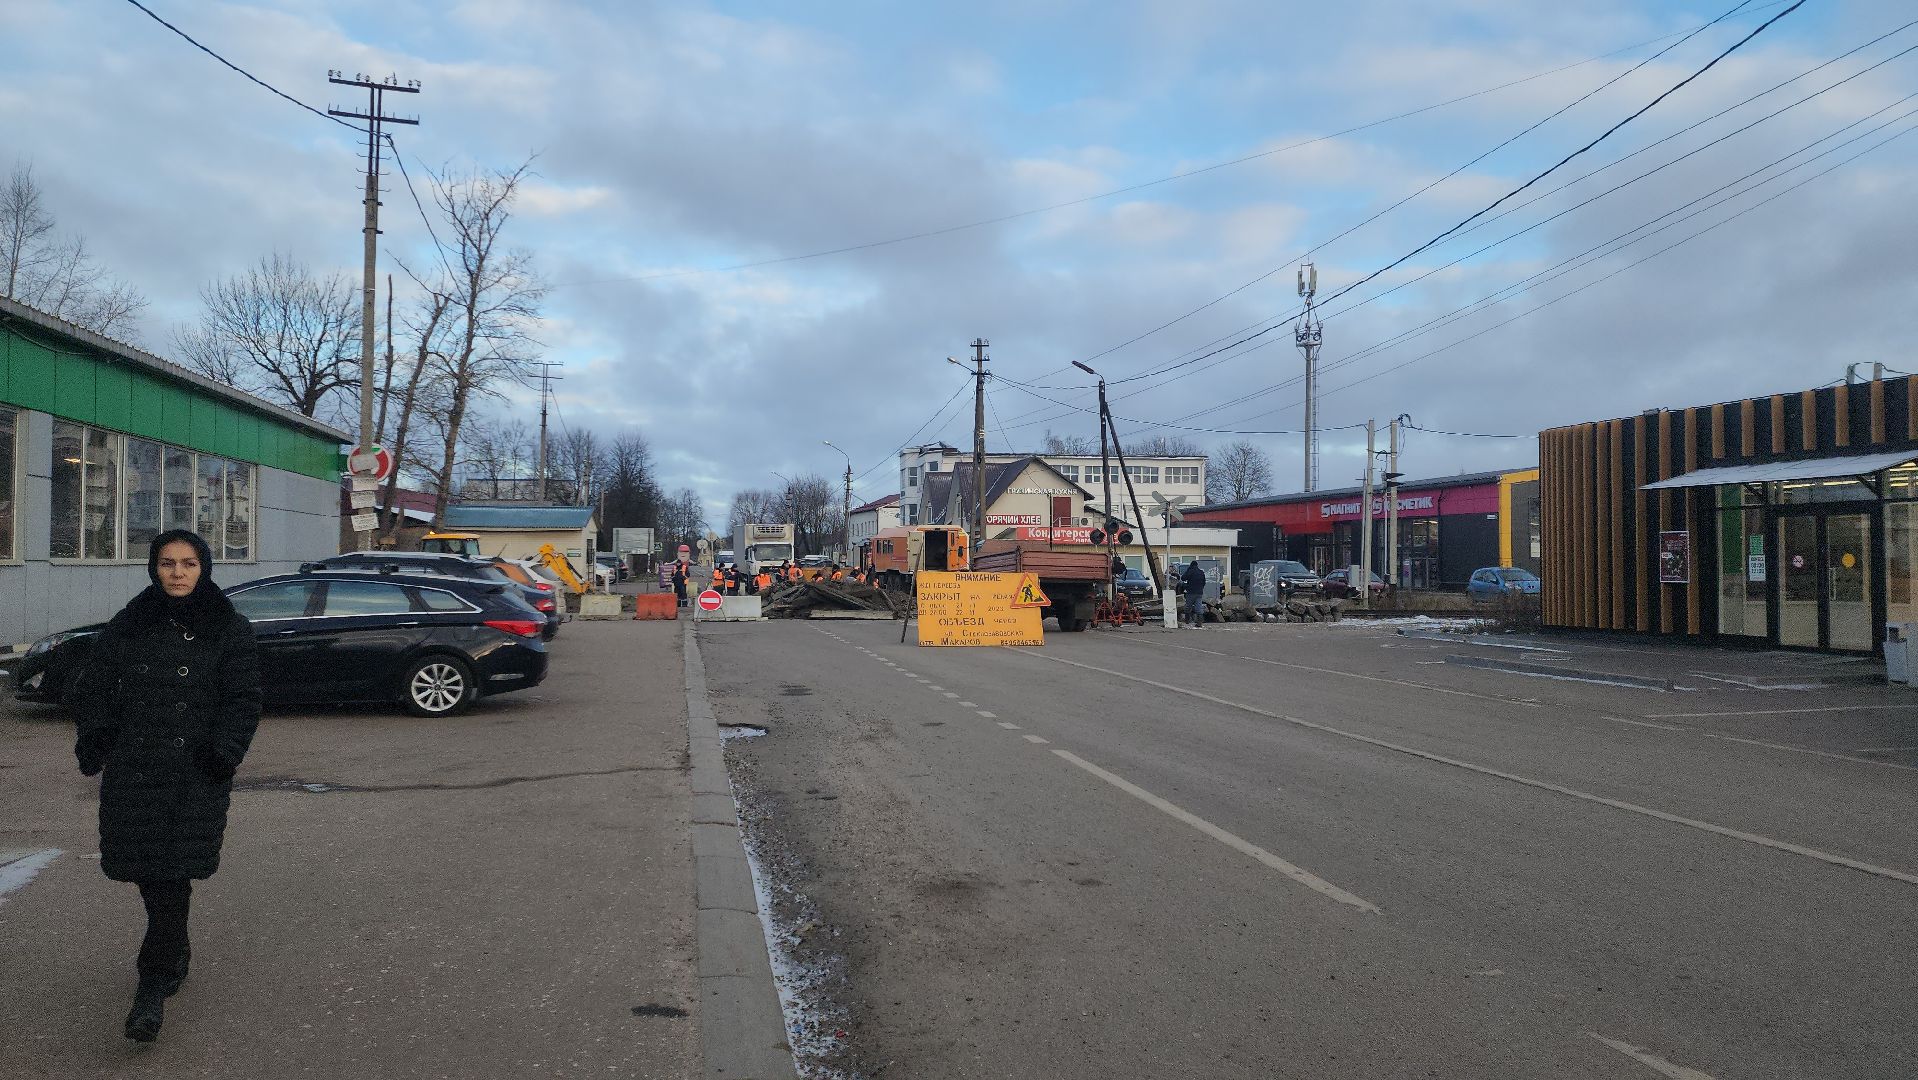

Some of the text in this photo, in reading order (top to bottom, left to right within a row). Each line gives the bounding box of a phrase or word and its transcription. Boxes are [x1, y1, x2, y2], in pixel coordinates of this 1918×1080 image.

[1330, 502, 1361, 515] МАГНИТ
[1021, 515, 1041, 525] ХЛЕБ
[955, 573, 1002, 582] ВНИМАНИЕ
[920, 592, 961, 601] ЗАКРЫТ
[938, 617, 985, 626] ОБЪЕЗД
